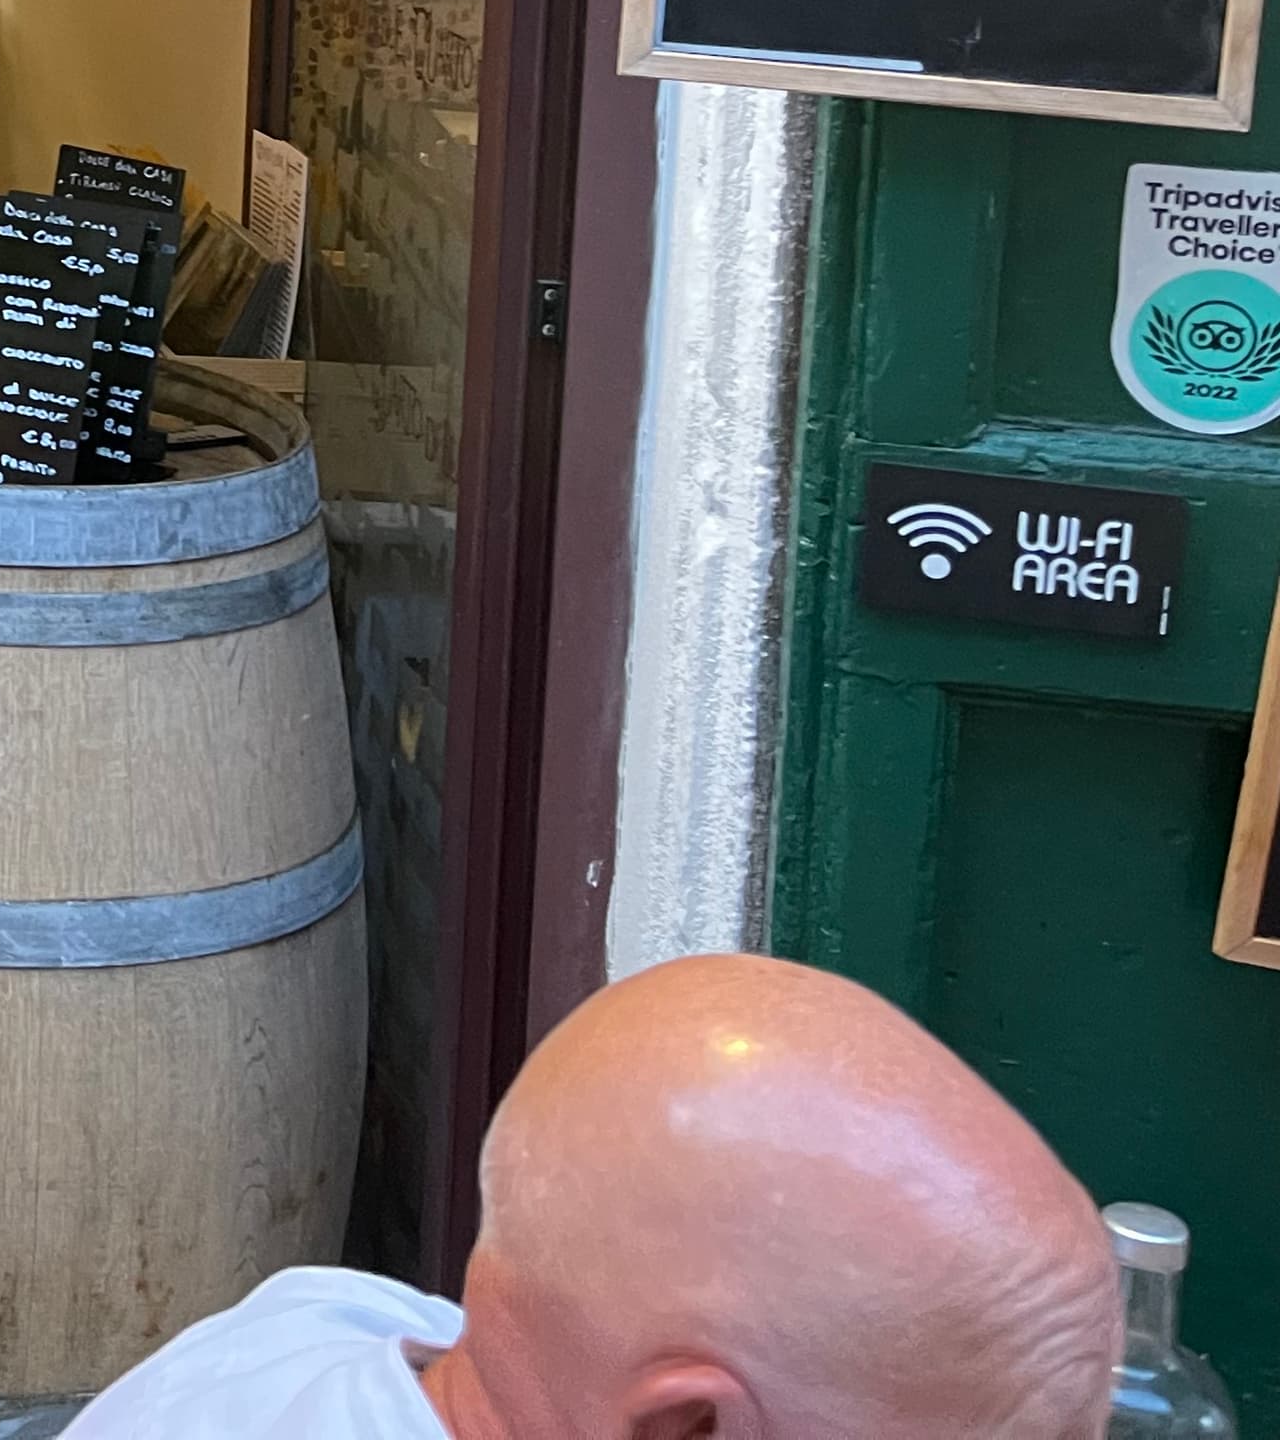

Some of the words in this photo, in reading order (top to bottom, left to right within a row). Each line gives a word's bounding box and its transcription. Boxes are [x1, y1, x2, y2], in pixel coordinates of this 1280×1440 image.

[1183, 381, 1239, 402] 2022
[1017, 509, 1134, 562] WI-FI
[1011, 553, 1139, 606] AREA
